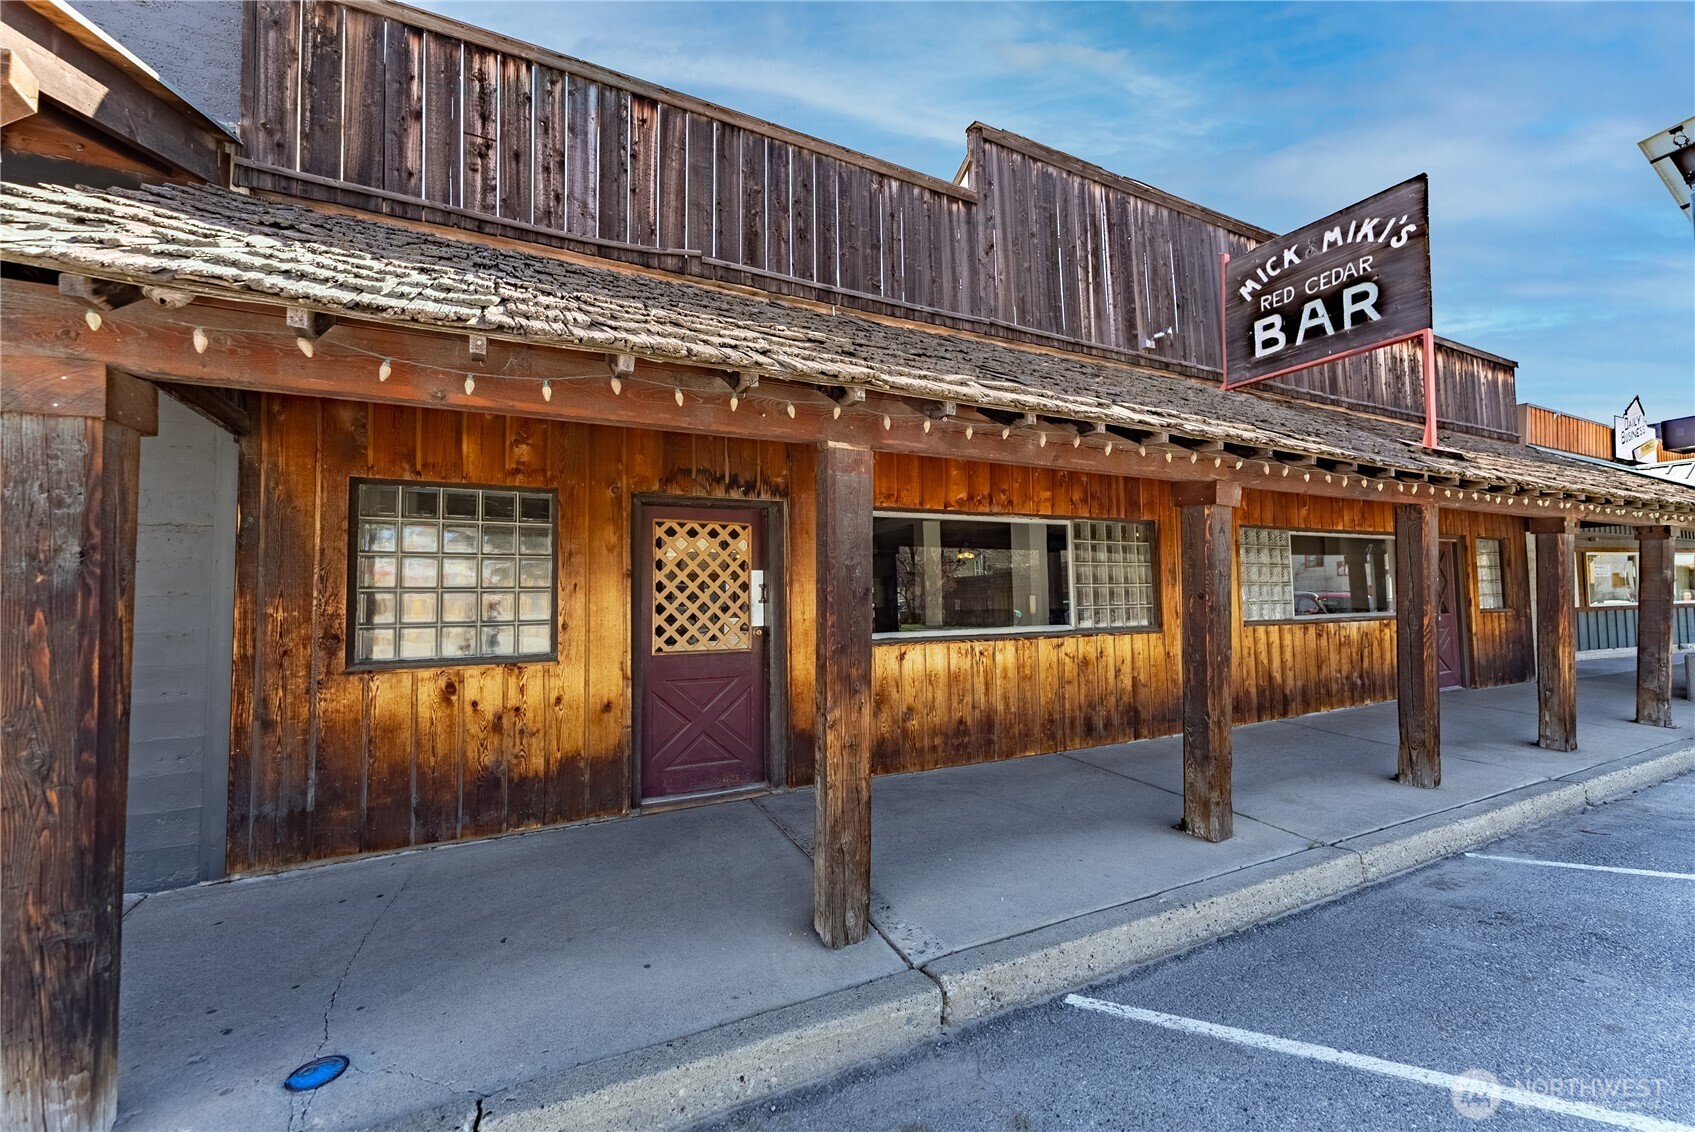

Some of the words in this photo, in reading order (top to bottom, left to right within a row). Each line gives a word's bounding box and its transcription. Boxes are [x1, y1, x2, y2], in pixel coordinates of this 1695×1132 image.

[1238, 244, 1302, 302] MICK
[1322, 214, 1418, 252] MIKI'S
[1260, 285, 1295, 312] RED
[1304, 255, 1374, 295] CEDAR
[1253, 281, 1383, 359] BAR
